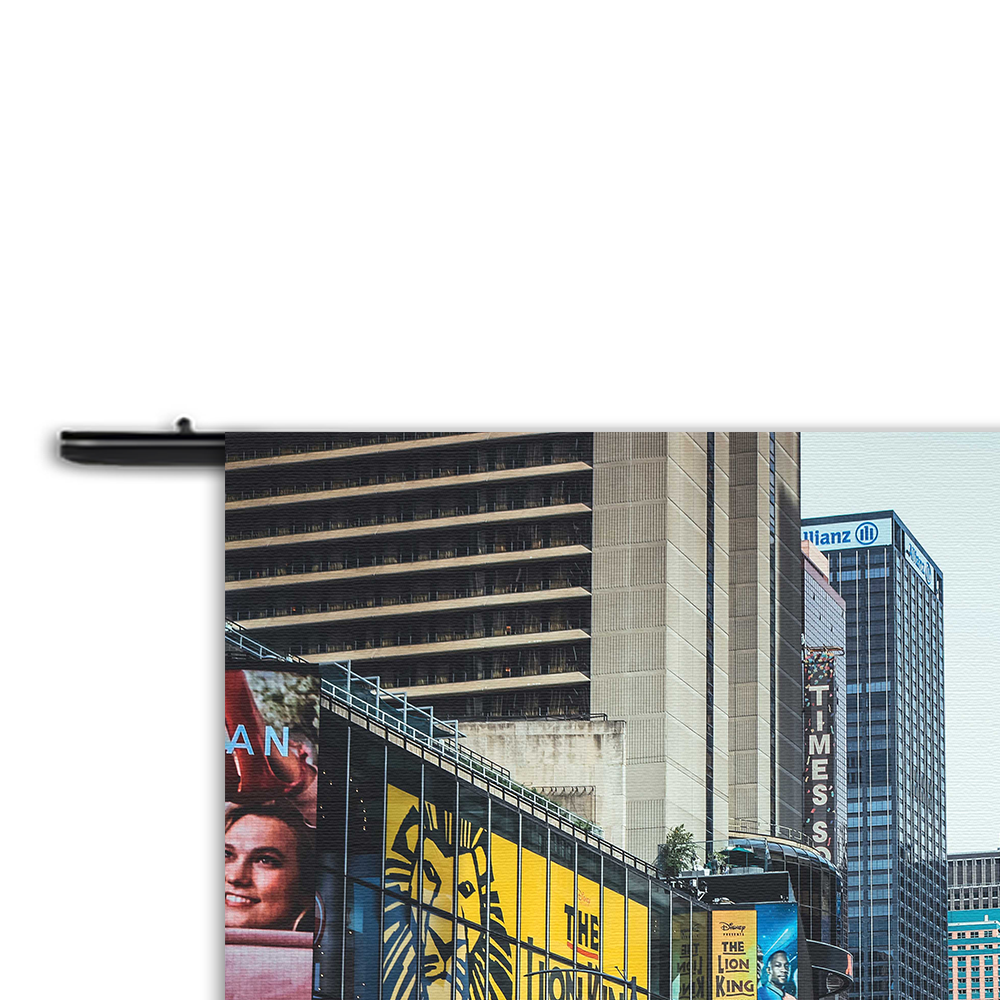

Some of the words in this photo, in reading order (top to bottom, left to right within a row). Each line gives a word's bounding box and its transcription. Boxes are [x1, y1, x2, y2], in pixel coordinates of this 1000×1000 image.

[808, 685, 831, 806] TIMES
[564, 903, 599, 952] THE
[719, 921, 746, 932] Disney
[721, 941, 744, 952] THE
[718, 955, 749, 974] LION
[715, 975, 754, 997] KING
